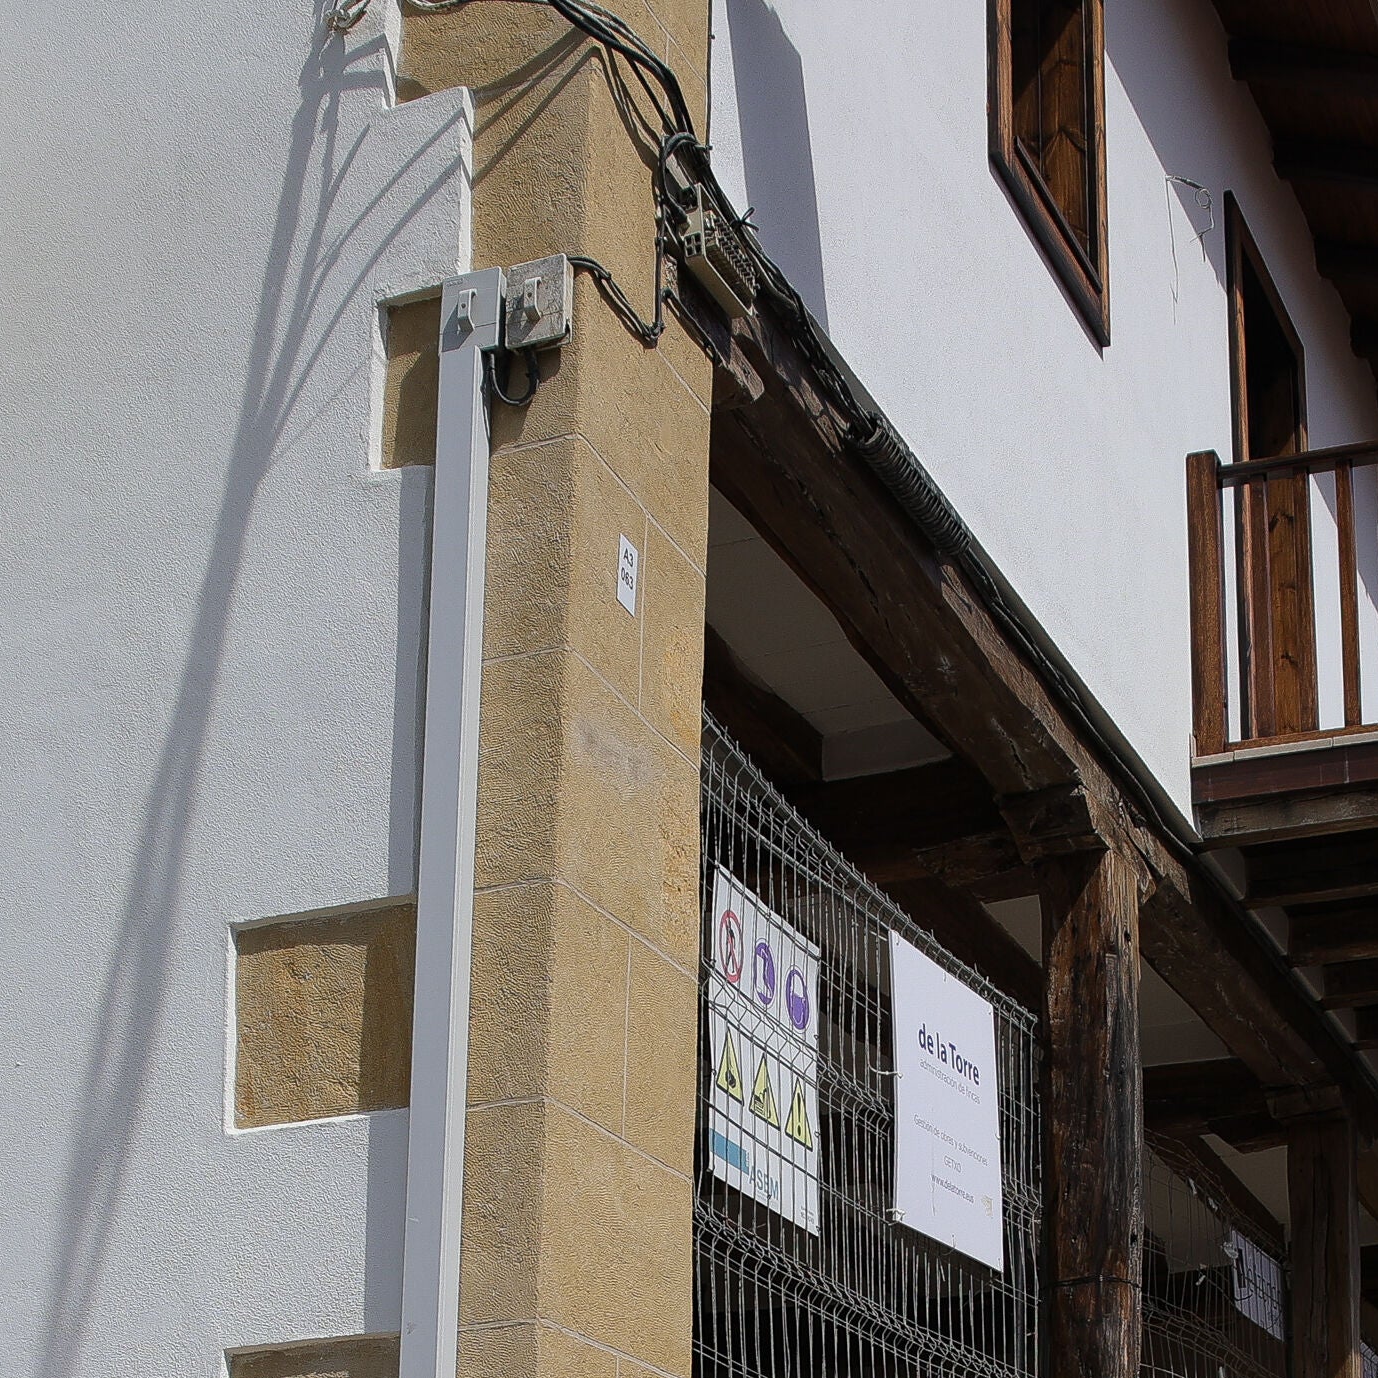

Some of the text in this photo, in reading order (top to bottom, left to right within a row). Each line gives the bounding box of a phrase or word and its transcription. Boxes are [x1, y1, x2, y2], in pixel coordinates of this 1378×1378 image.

[623, 547, 634, 567] A3
[620, 567, 634, 590] 063
[918, 1023, 980, 1086] de la Torre
[943, 1155, 962, 1173] GETXO
